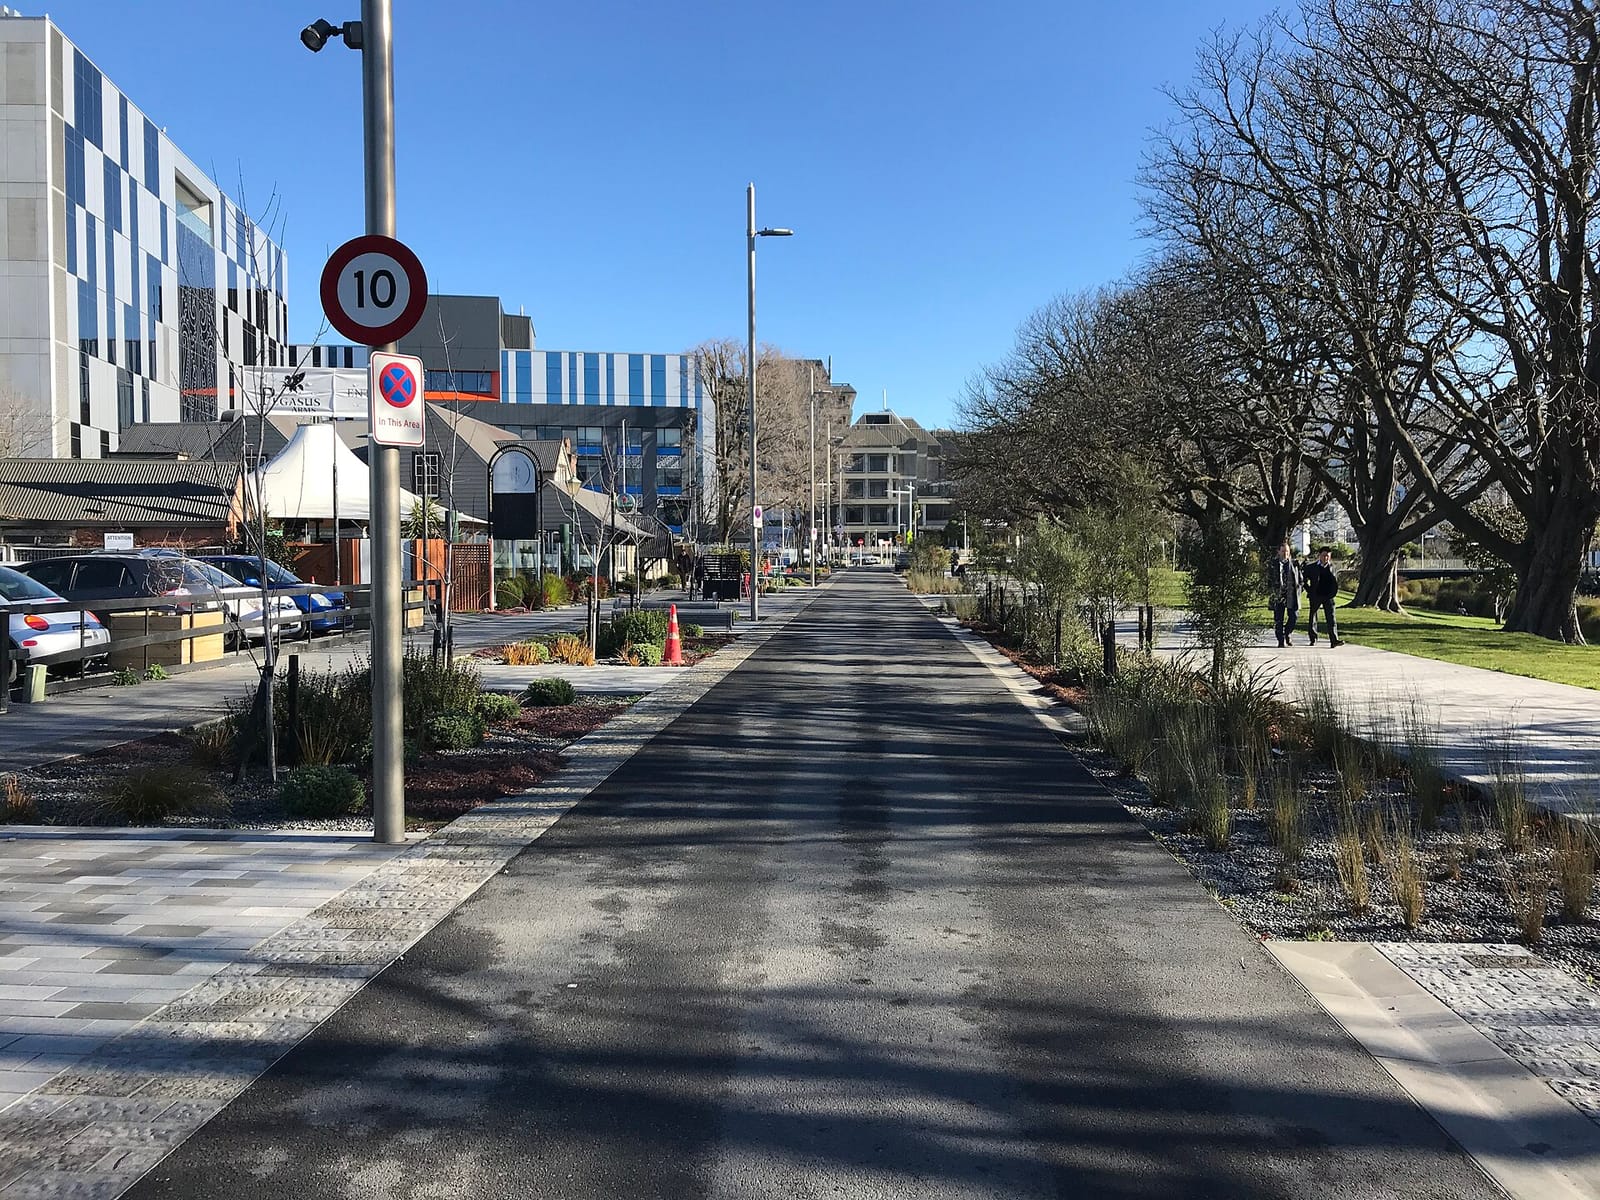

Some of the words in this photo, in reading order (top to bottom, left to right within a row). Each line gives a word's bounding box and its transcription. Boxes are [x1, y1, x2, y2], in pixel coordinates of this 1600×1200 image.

[353, 269, 397, 309] 10
[378, 416, 386, 425] In
[387, 417, 402, 427] This
[403, 419, 420, 428] Area
